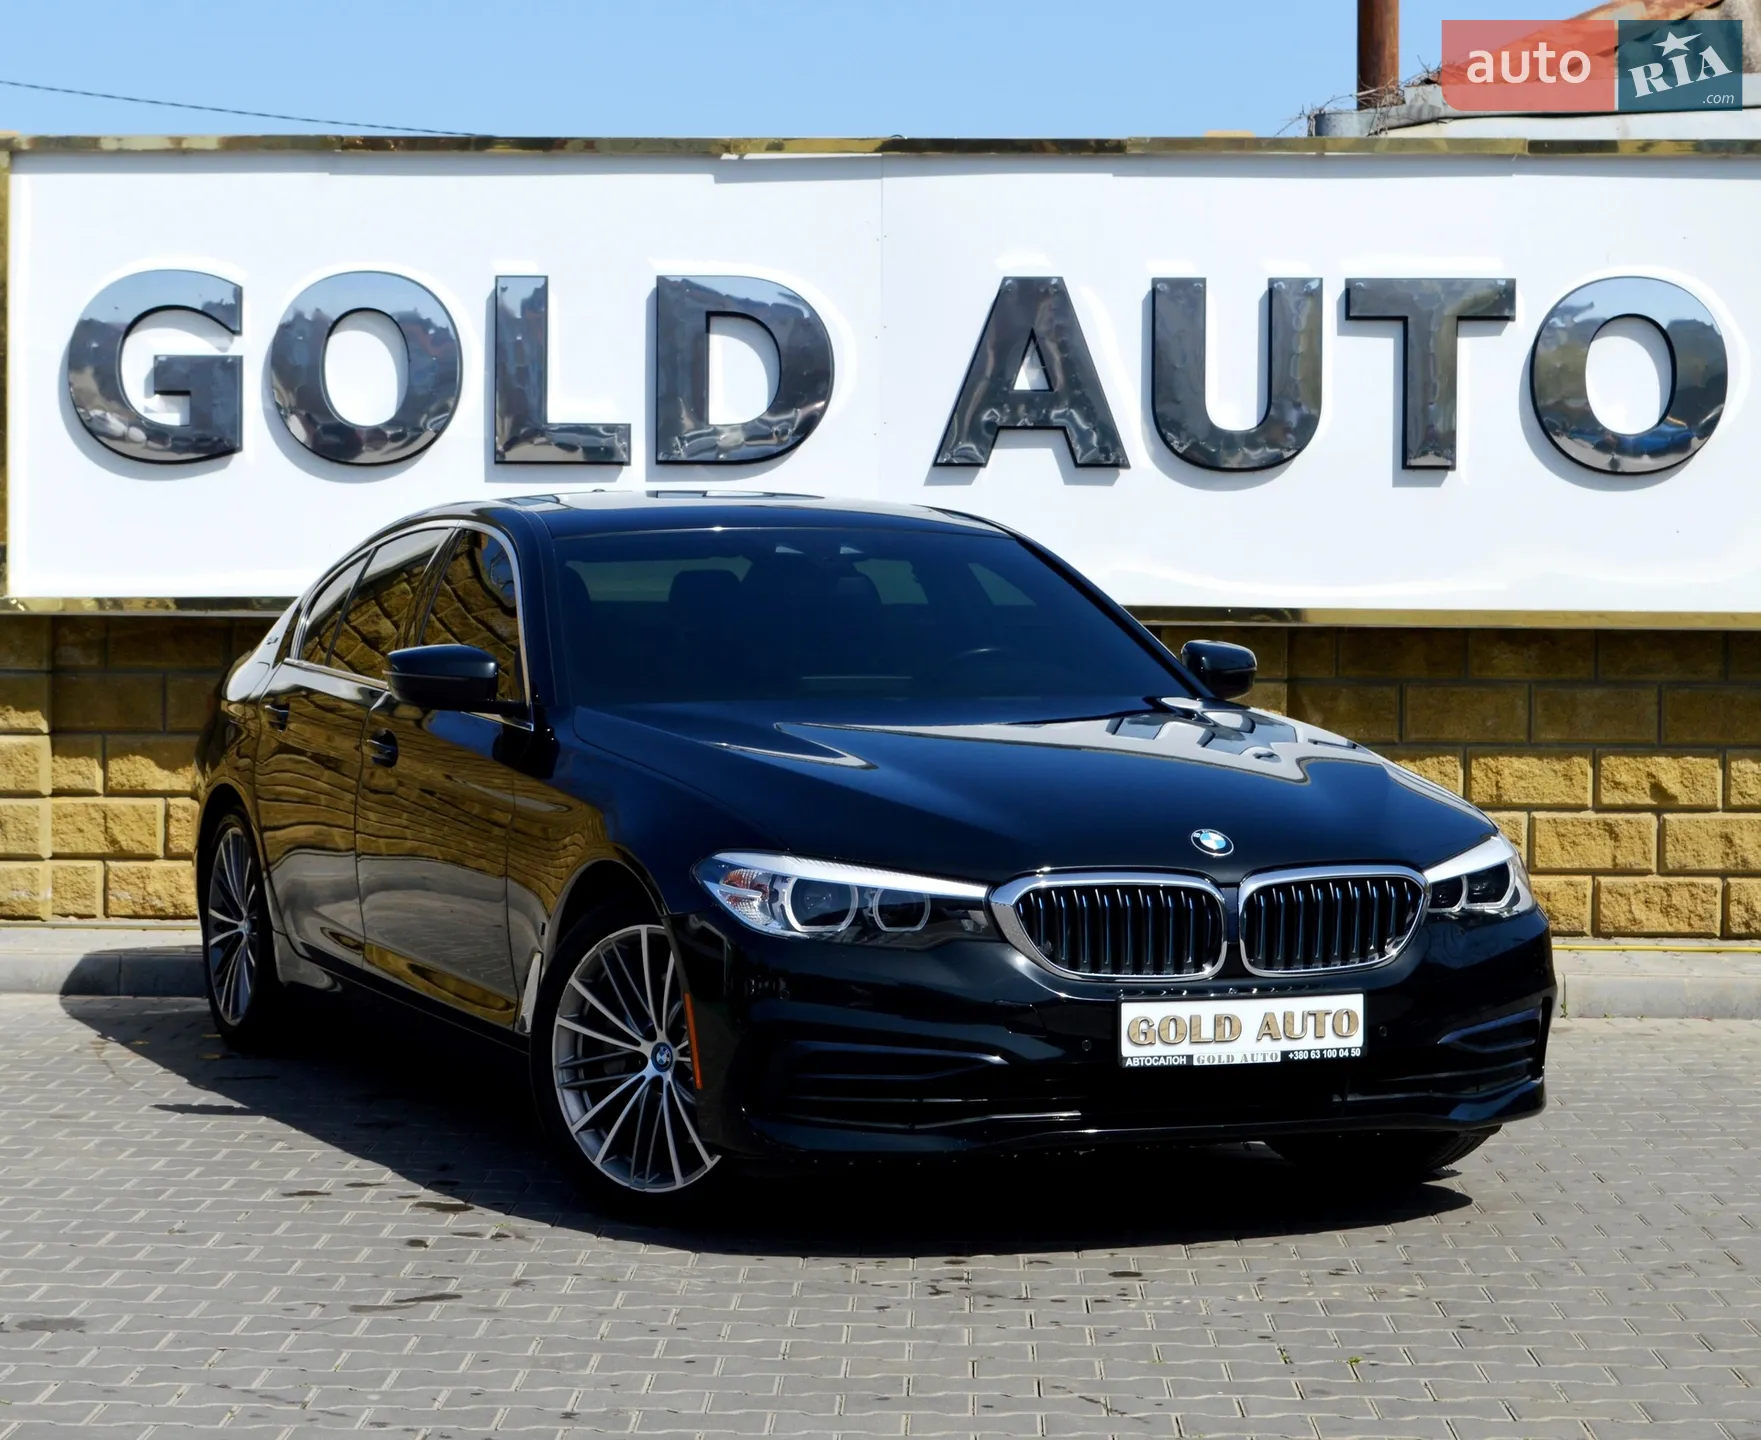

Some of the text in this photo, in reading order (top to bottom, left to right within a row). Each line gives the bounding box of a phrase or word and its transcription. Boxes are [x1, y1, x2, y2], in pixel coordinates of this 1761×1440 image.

[68, 269, 1728, 475] GOLD AUTO
[1127, 1008, 1360, 1046] GOLD AUTO
[1196, 1052, 1279, 1065] GOLD AUTO
[1288, 1047, 1361, 1060] +380 63 100 04 50
[1125, 1055, 1187, 1067] АВТОСАЛОН
